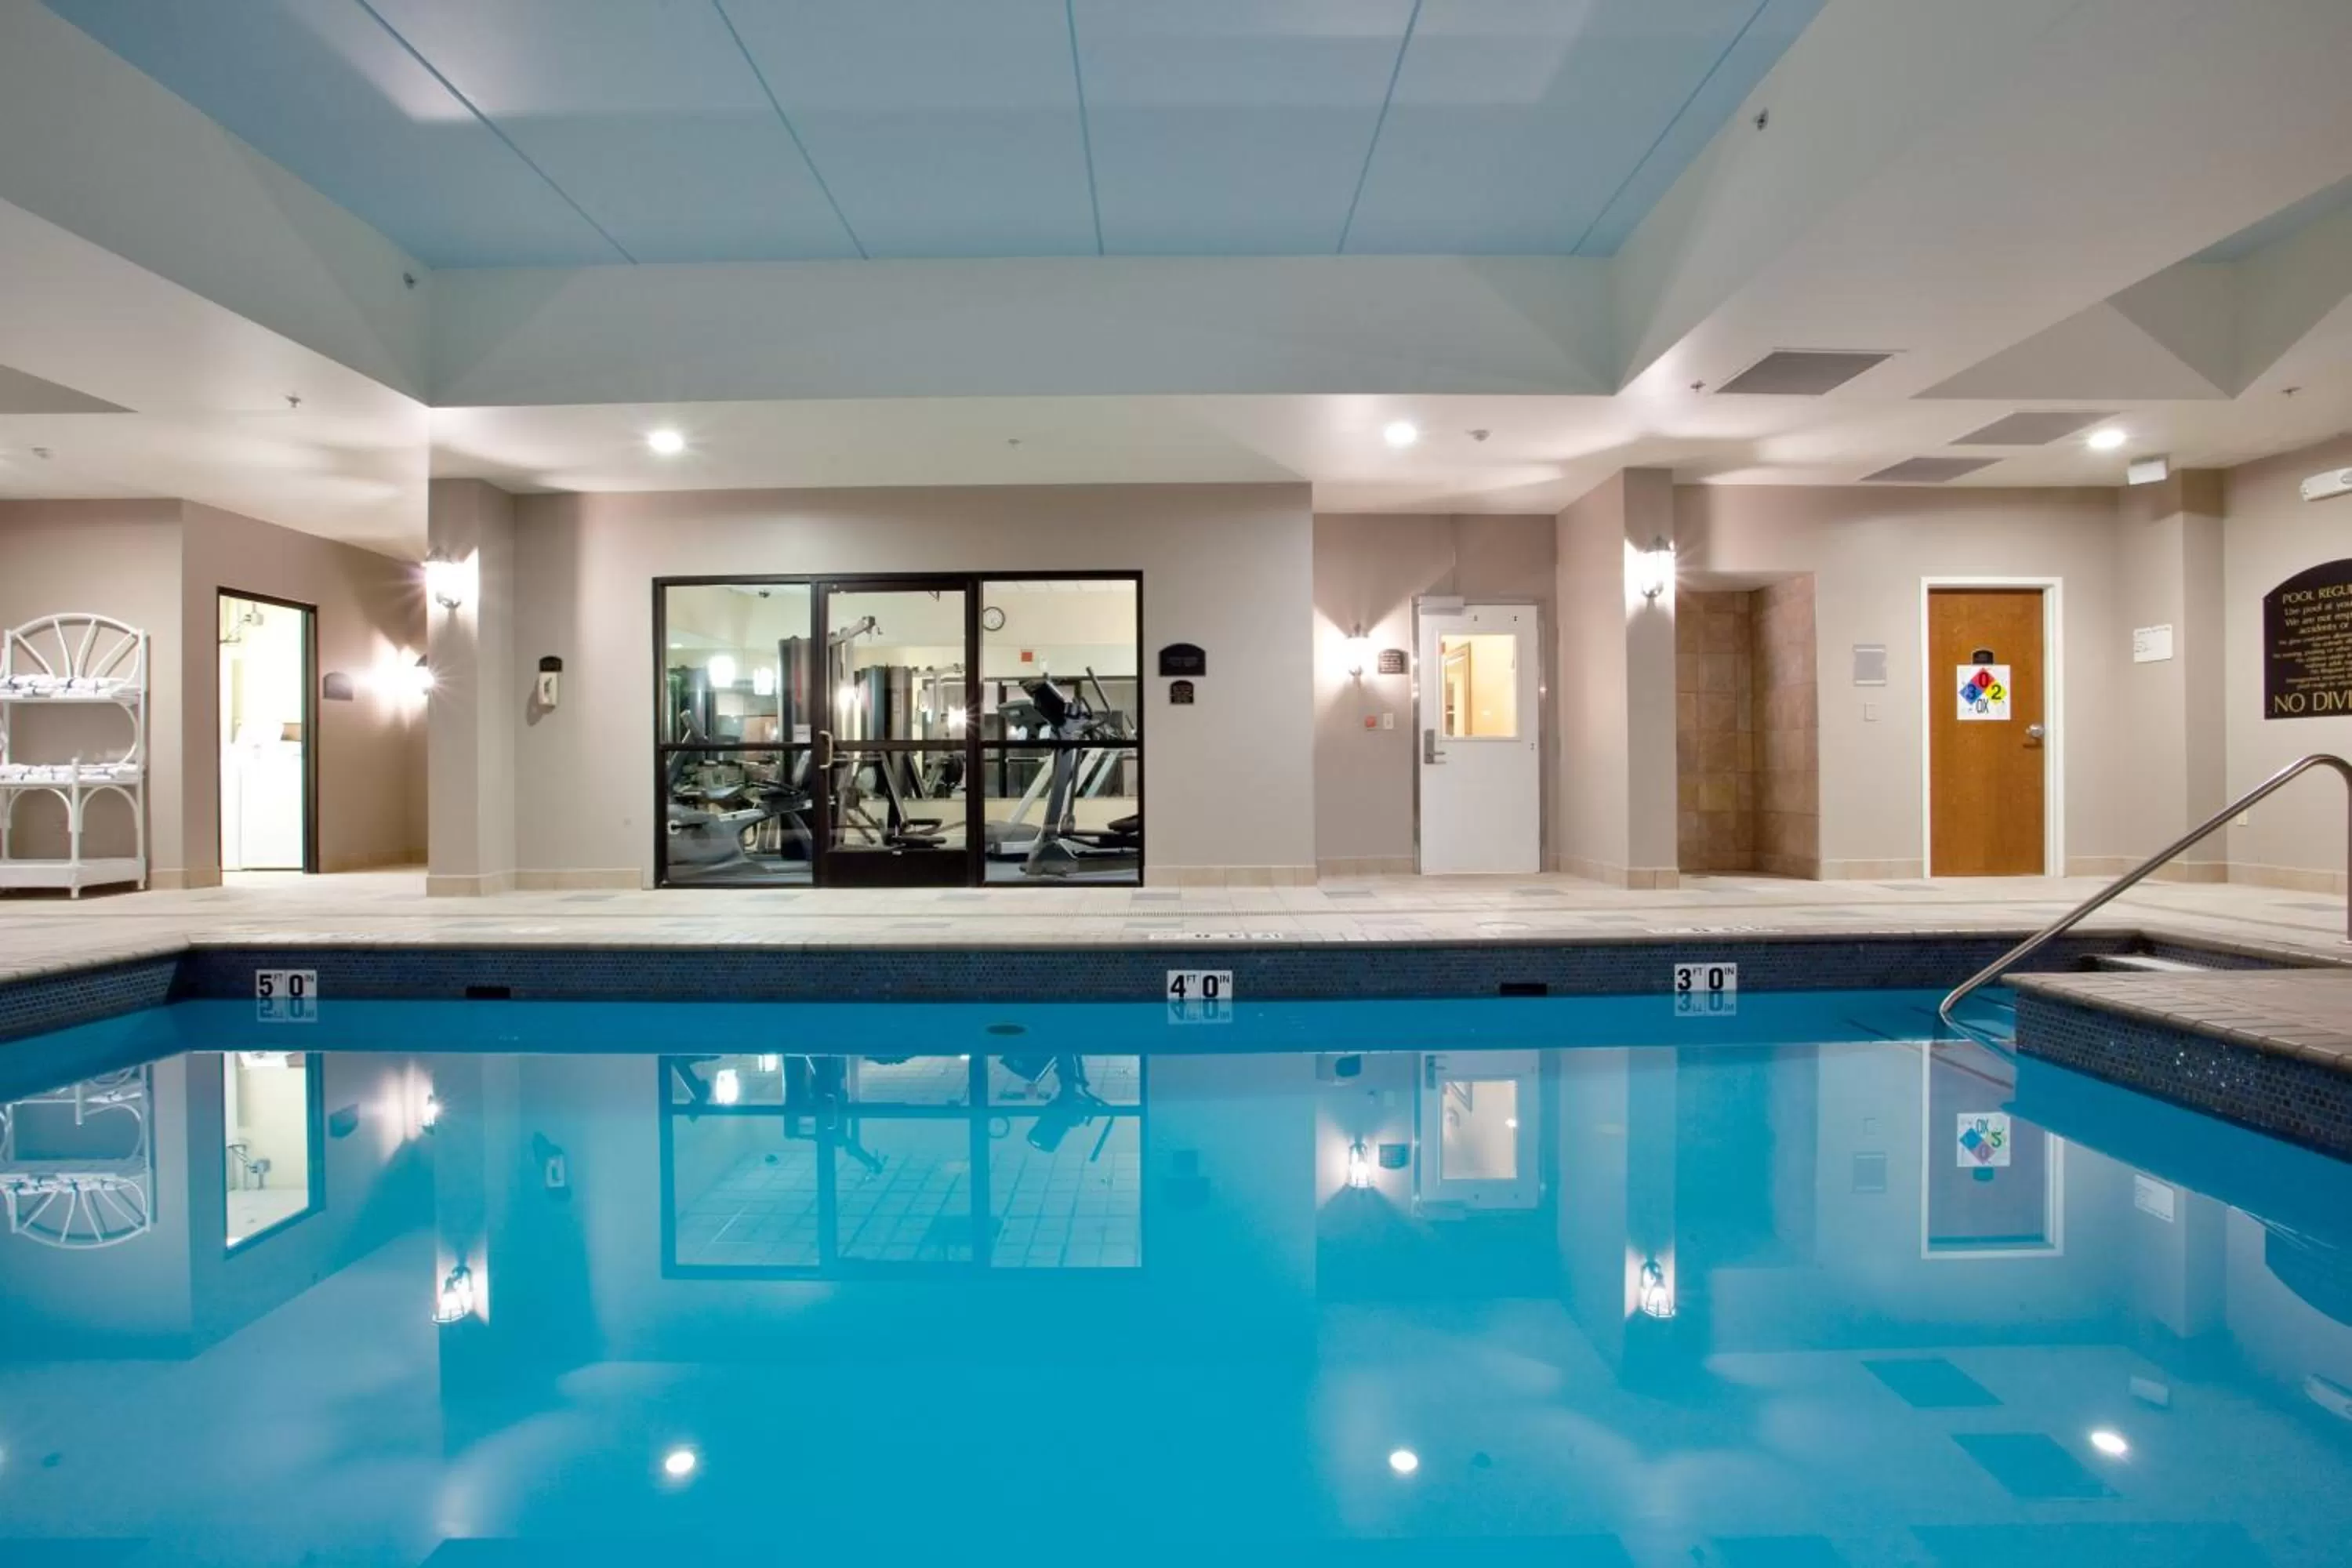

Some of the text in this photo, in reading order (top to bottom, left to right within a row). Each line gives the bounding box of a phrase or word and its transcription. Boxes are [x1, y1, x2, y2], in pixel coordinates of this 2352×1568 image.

[2282, 590, 2315, 604] POOL
[2303, 602, 2321, 615] pool
[2285, 617, 2299, 627] We
[2302, 616, 2315, 625] are
[1979, 671, 1989, 688] 0
[1965, 683, 2002, 700] 3 2
[2274, 692, 2306, 713] NO
[259, 974, 274, 996] 5
[289, 975, 303, 996] 0
[1678, 965, 1735, 990] 3 FT 0 IN
[1170, 975, 1230, 998] 4 FT 0 IN
